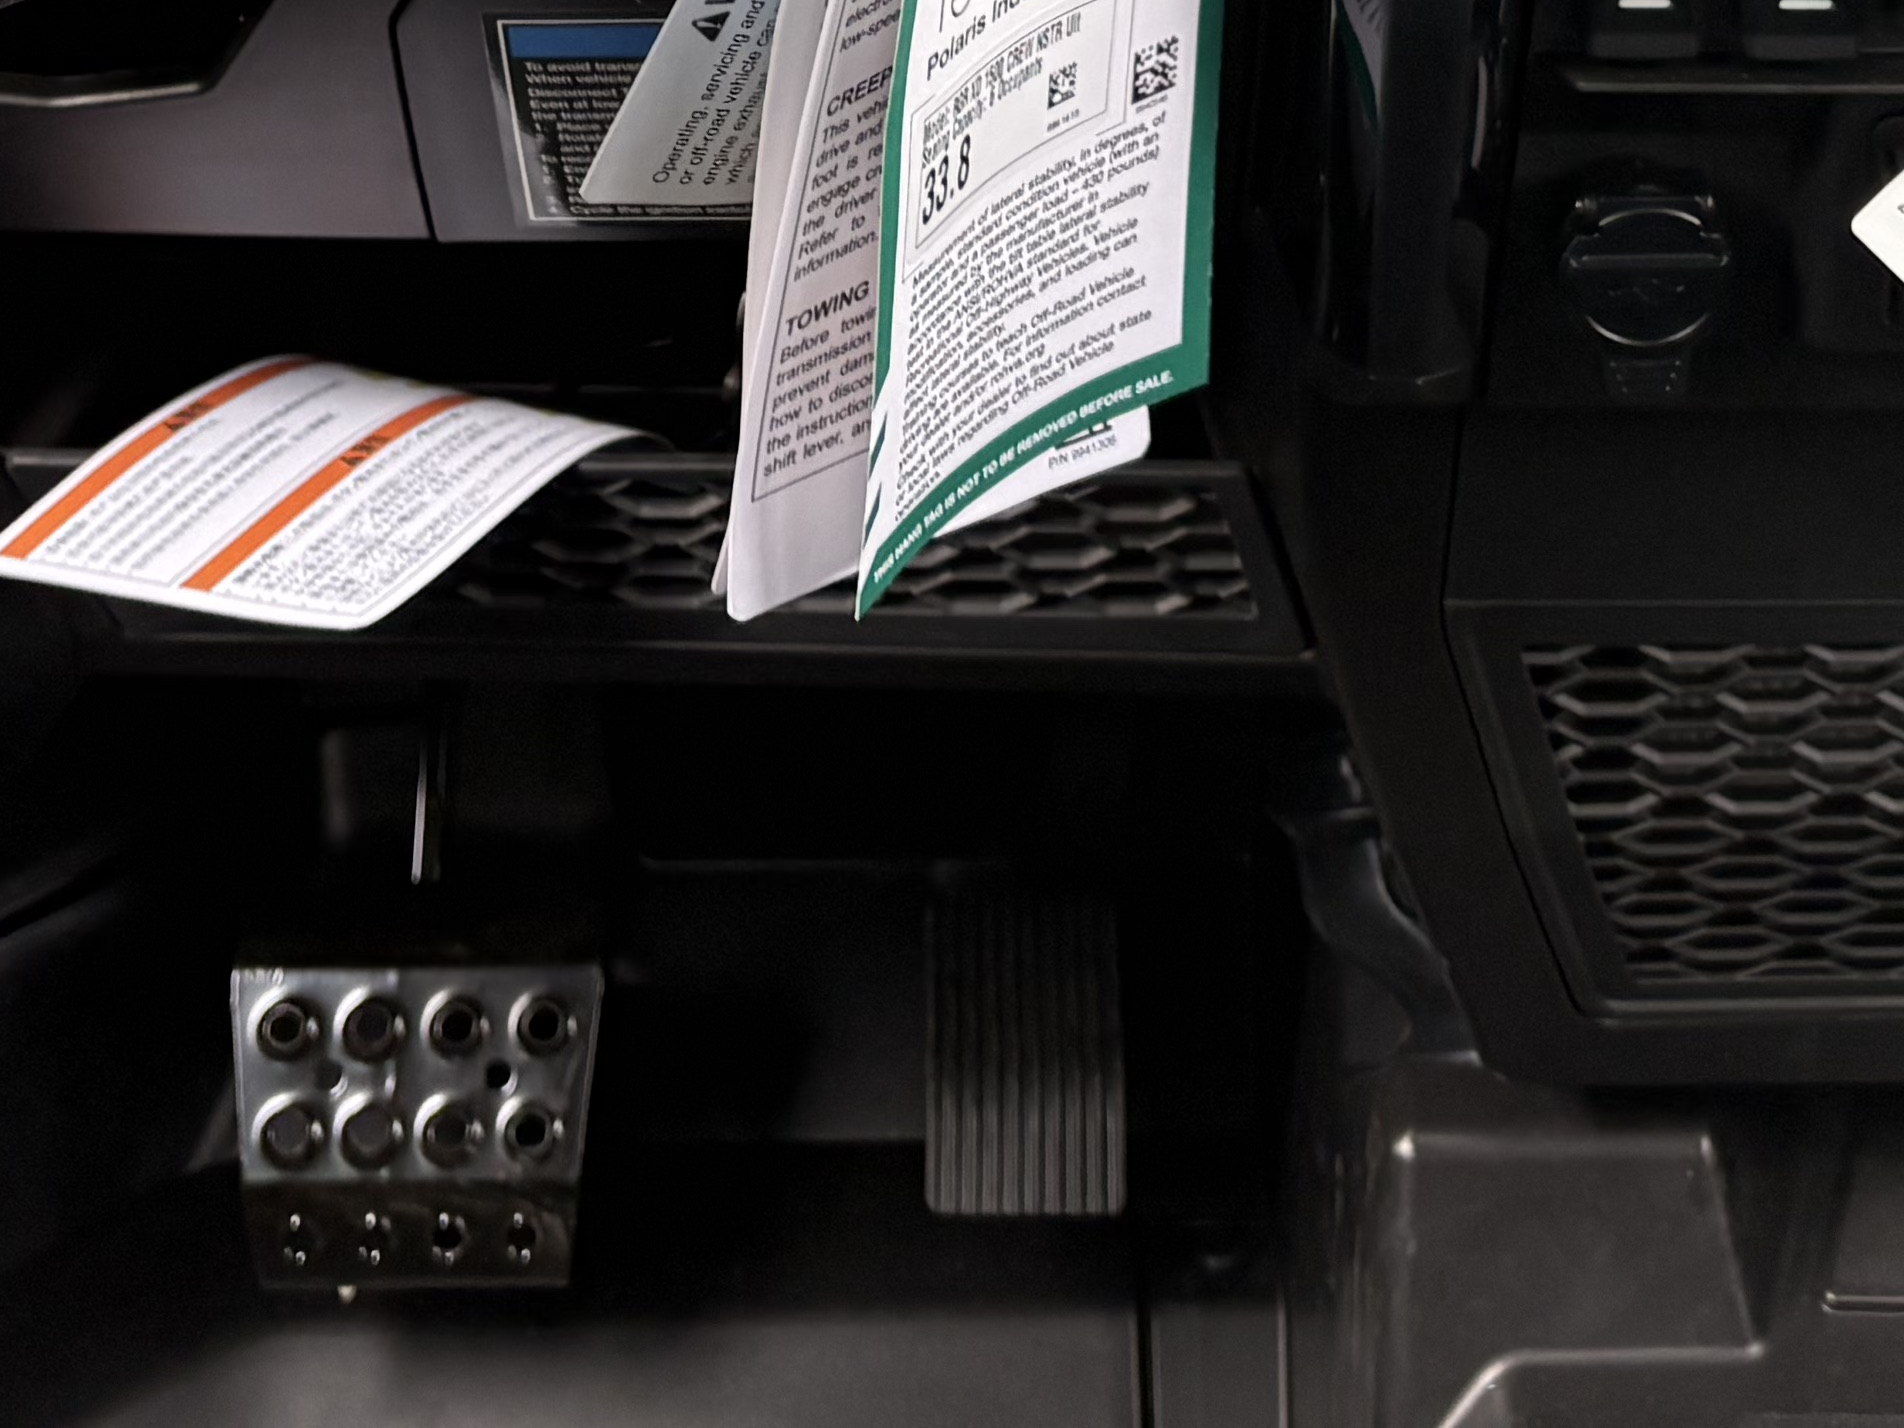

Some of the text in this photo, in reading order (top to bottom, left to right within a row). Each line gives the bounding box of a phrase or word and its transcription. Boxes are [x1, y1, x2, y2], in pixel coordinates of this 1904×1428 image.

[700, 32, 750, 101] servicing
[927, 14, 986, 81] Polaris
[724, 50, 762, 103] vehicle
[821, 117, 850, 144] This
[845, 154, 859, 171] is
[922, 135, 971, 225] 33.8
[801, 214, 825, 237] the
[850, 214, 866, 232] to
[786, 280, 869, 336] TOWING
[775, 330, 872, 386] transmission
[779, 329, 830, 364] Before
[771, 368, 831, 413] prevent
[768, 396, 824, 432] how to
[1015, 409, 1078, 454] REMOVED
[1078, 384, 1132, 418] BEFORE
[762, 430, 844, 477] shift lever,
[765, 432, 791, 455] the
